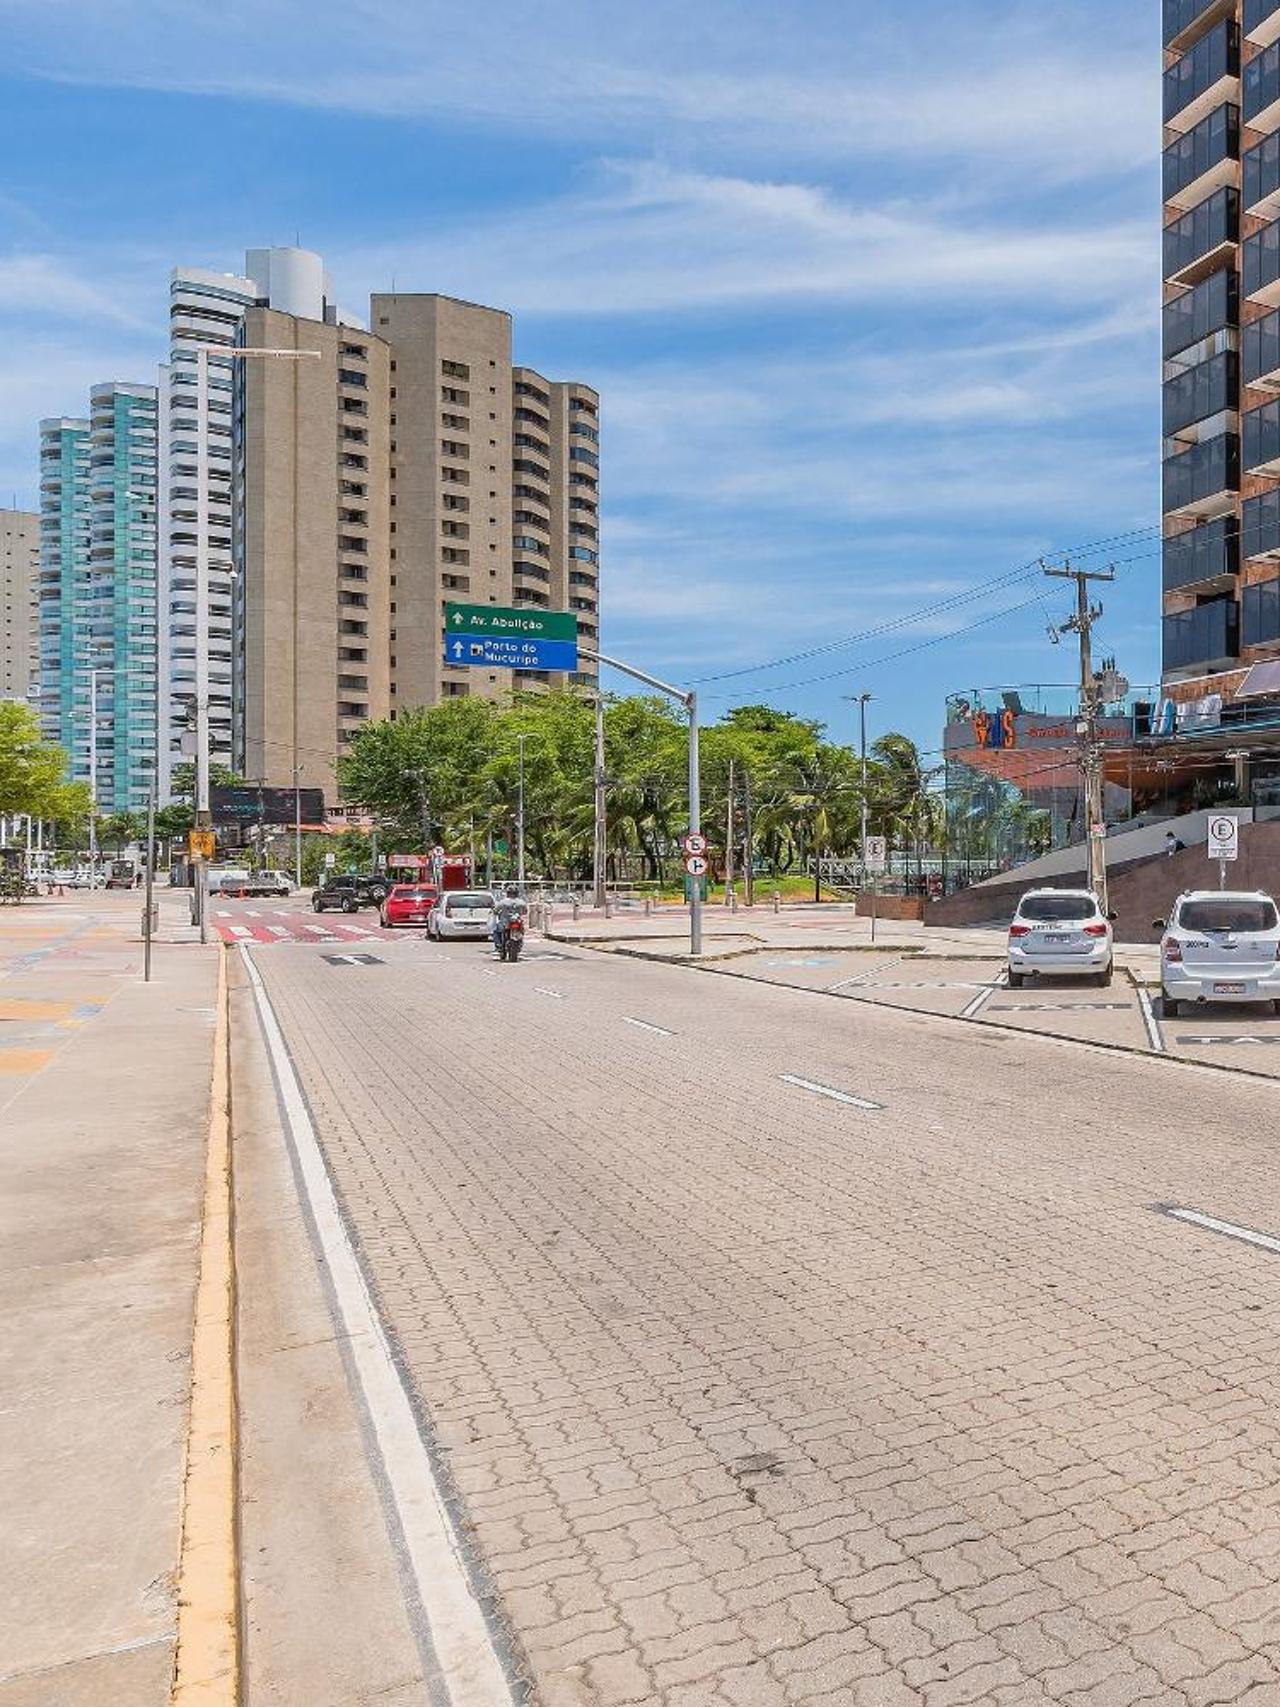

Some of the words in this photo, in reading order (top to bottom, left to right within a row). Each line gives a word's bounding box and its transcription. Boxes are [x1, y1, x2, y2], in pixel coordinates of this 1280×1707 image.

[470, 615, 487, 626] Av.
[491, 617, 543, 631] Abolição
[484, 641, 517, 653] Porto
[521, 644, 536, 654] do
[484, 652, 538, 666] Mucuripe
